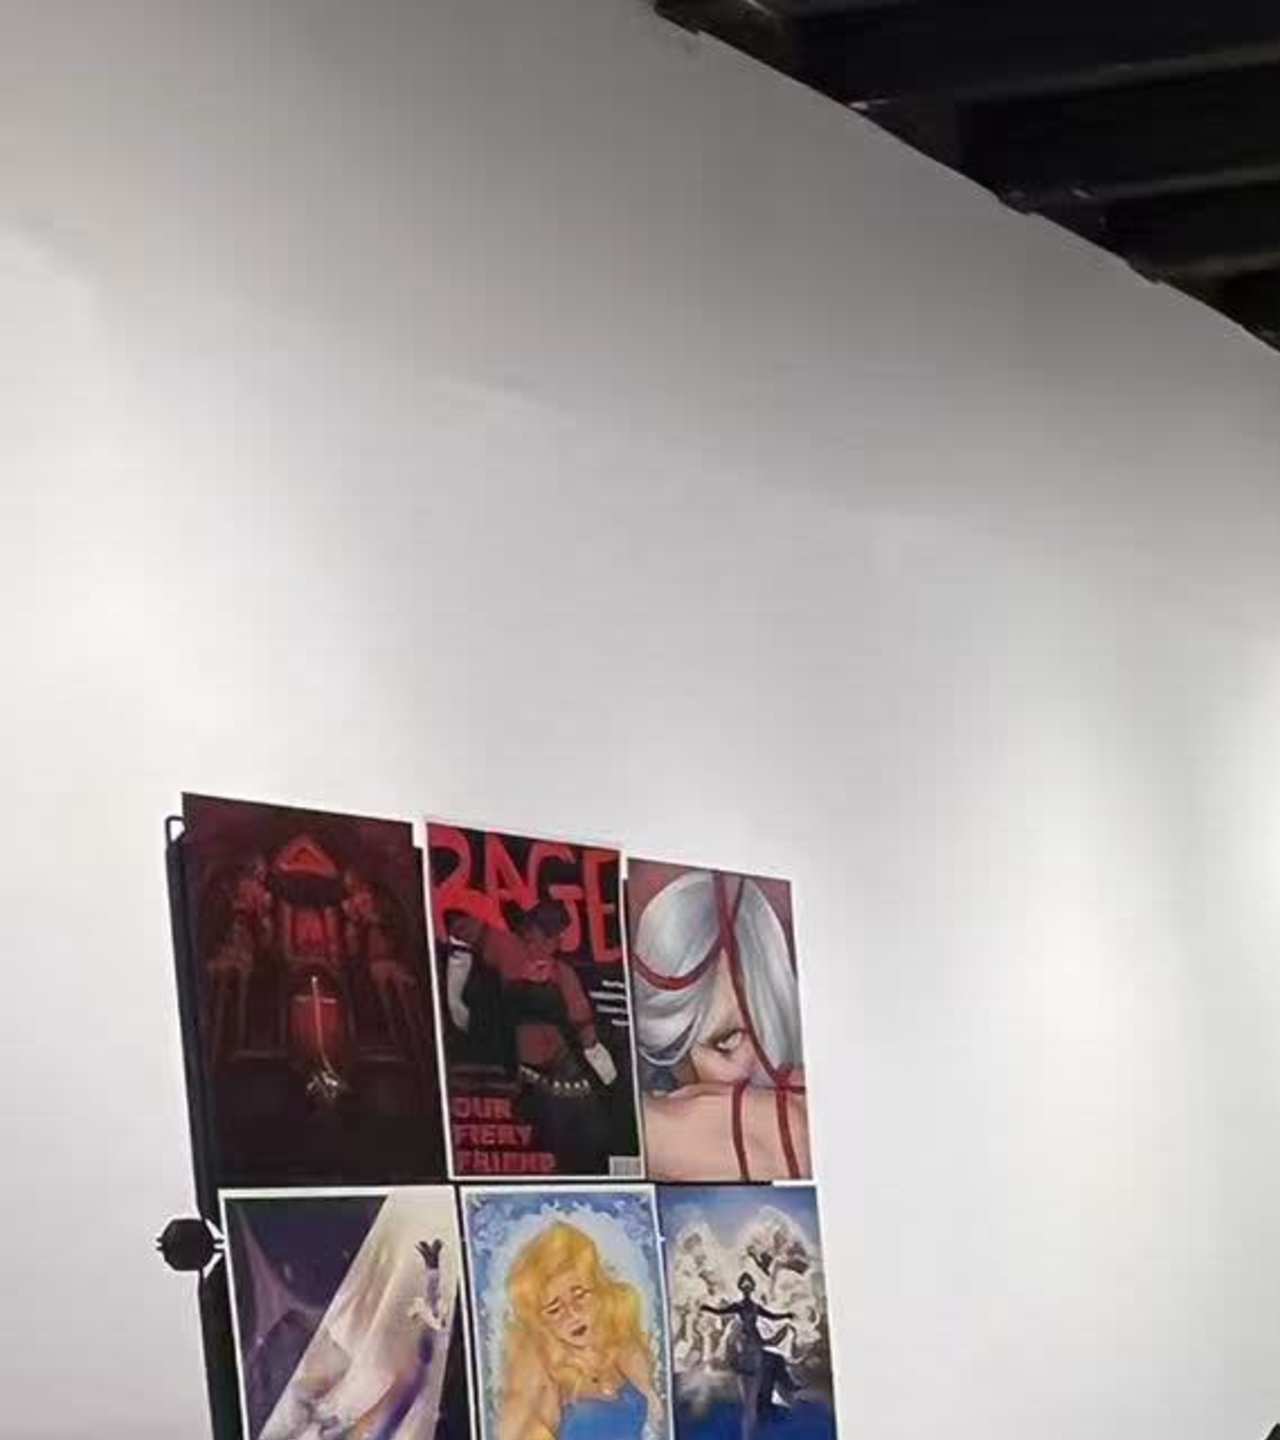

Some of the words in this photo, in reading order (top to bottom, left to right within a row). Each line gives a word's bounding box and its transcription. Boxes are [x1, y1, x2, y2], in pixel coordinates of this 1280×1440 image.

[453, 1098, 512, 1119] OUR
[454, 1123, 533, 1145] FIERY
[455, 1151, 557, 1175] FRIEND
